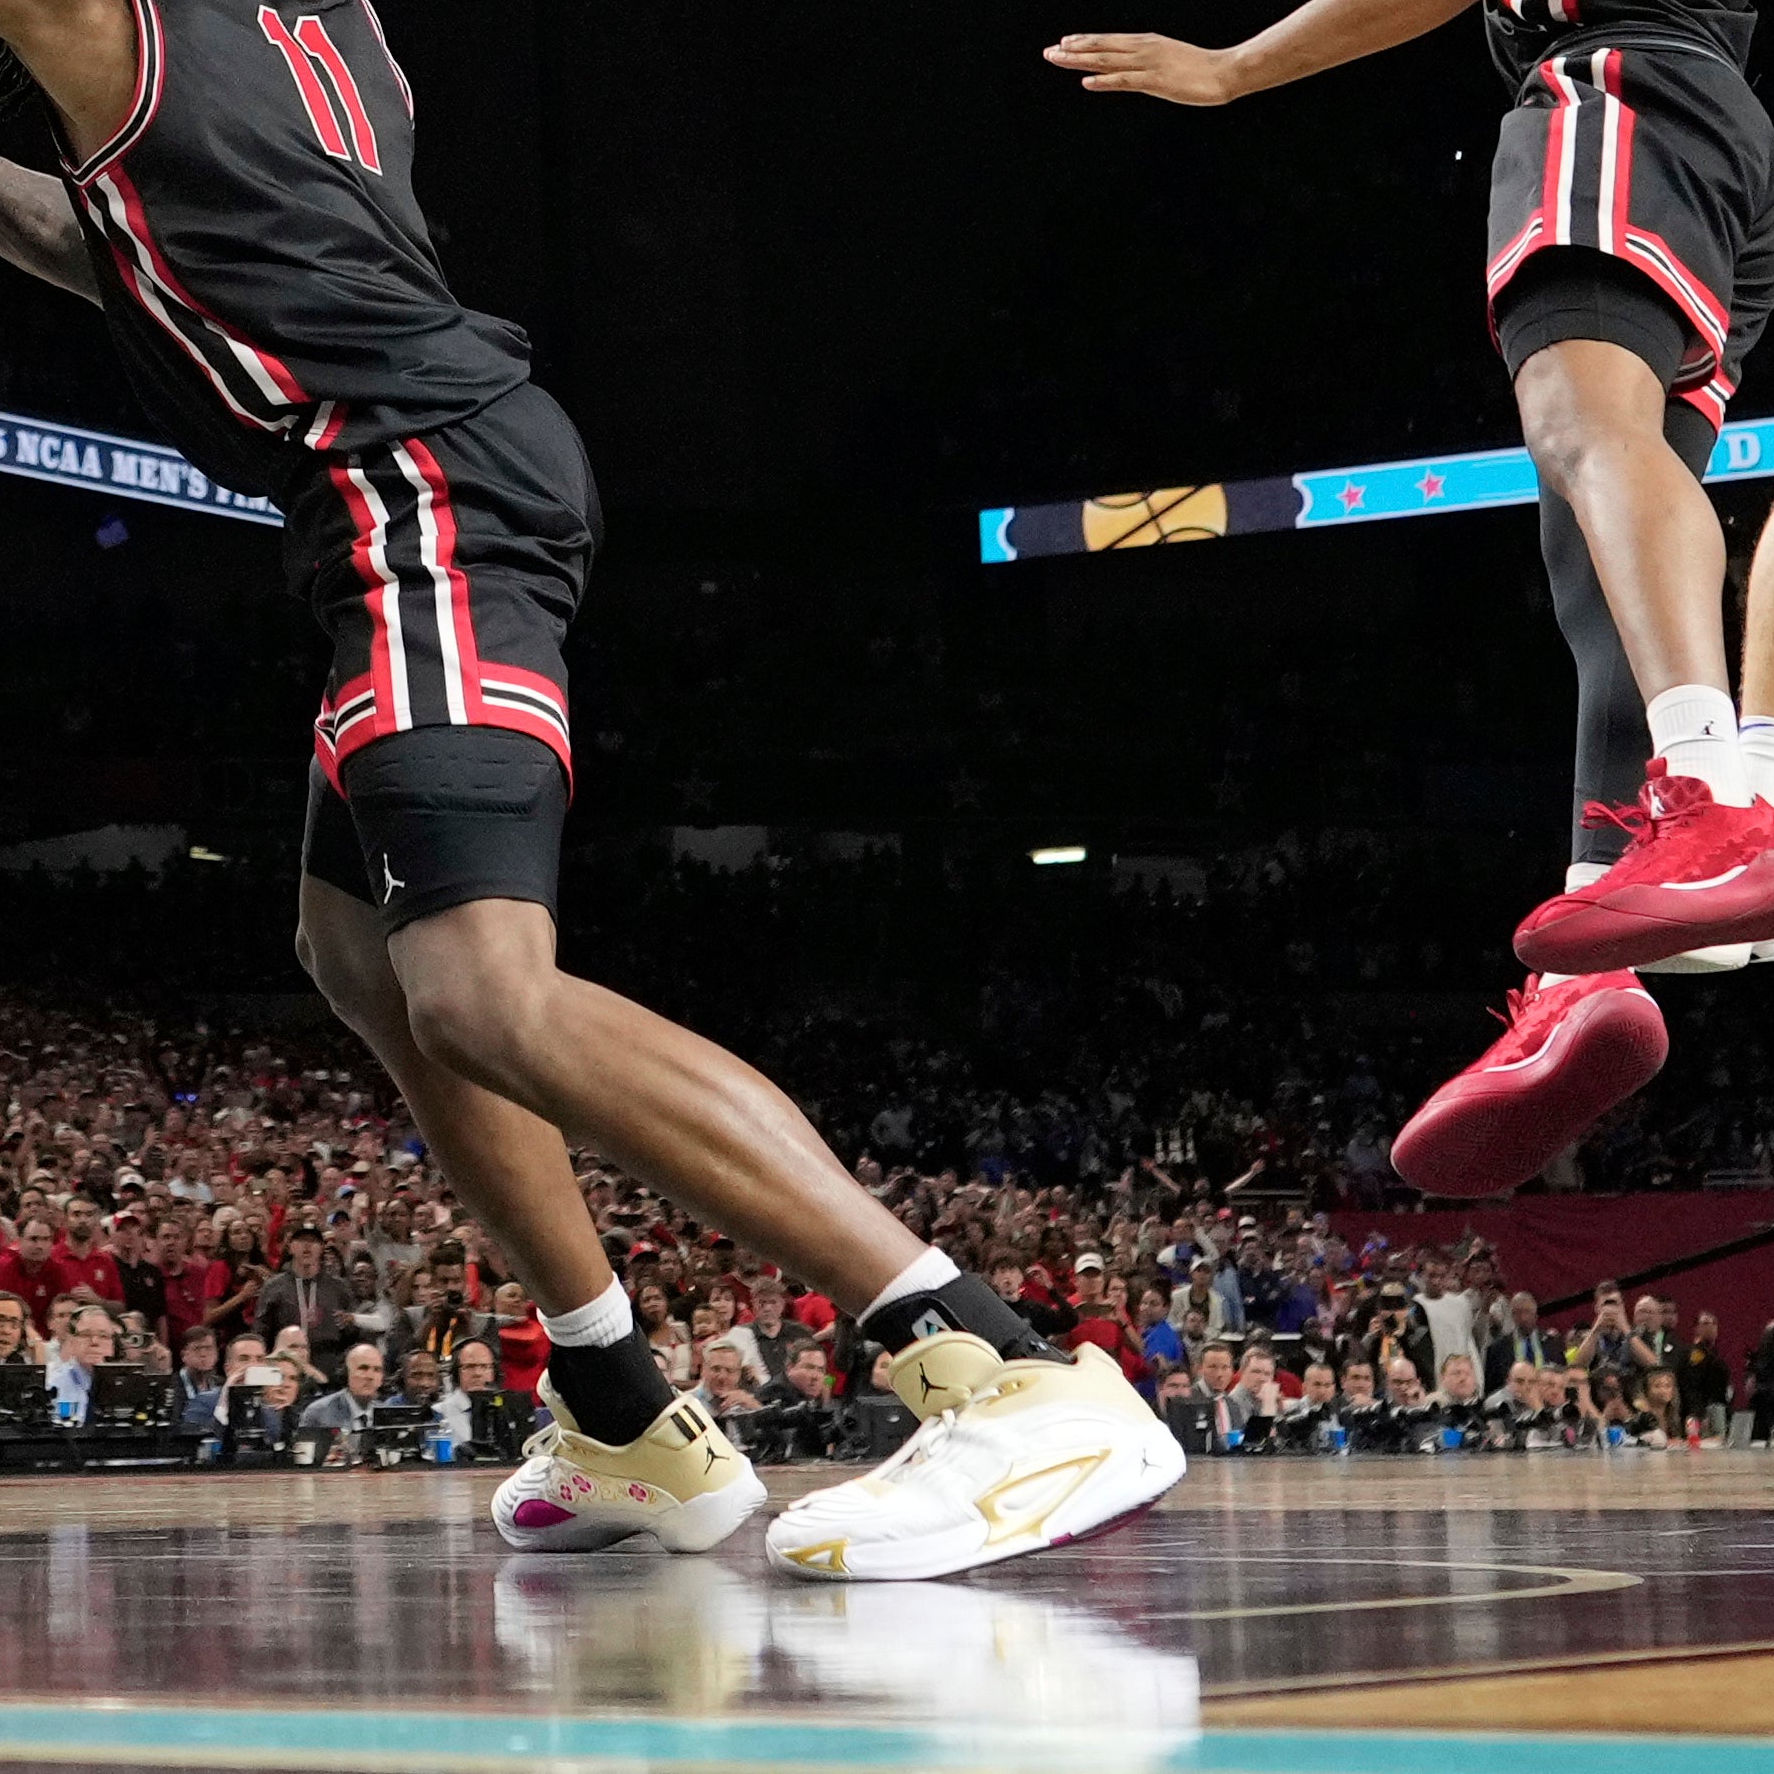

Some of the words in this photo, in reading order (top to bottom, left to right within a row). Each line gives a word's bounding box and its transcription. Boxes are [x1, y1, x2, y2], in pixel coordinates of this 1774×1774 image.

[257, 5, 383, 176] 11
[15, 430, 103, 479] NCAA
[111, 451, 208, 499] MEN'S
